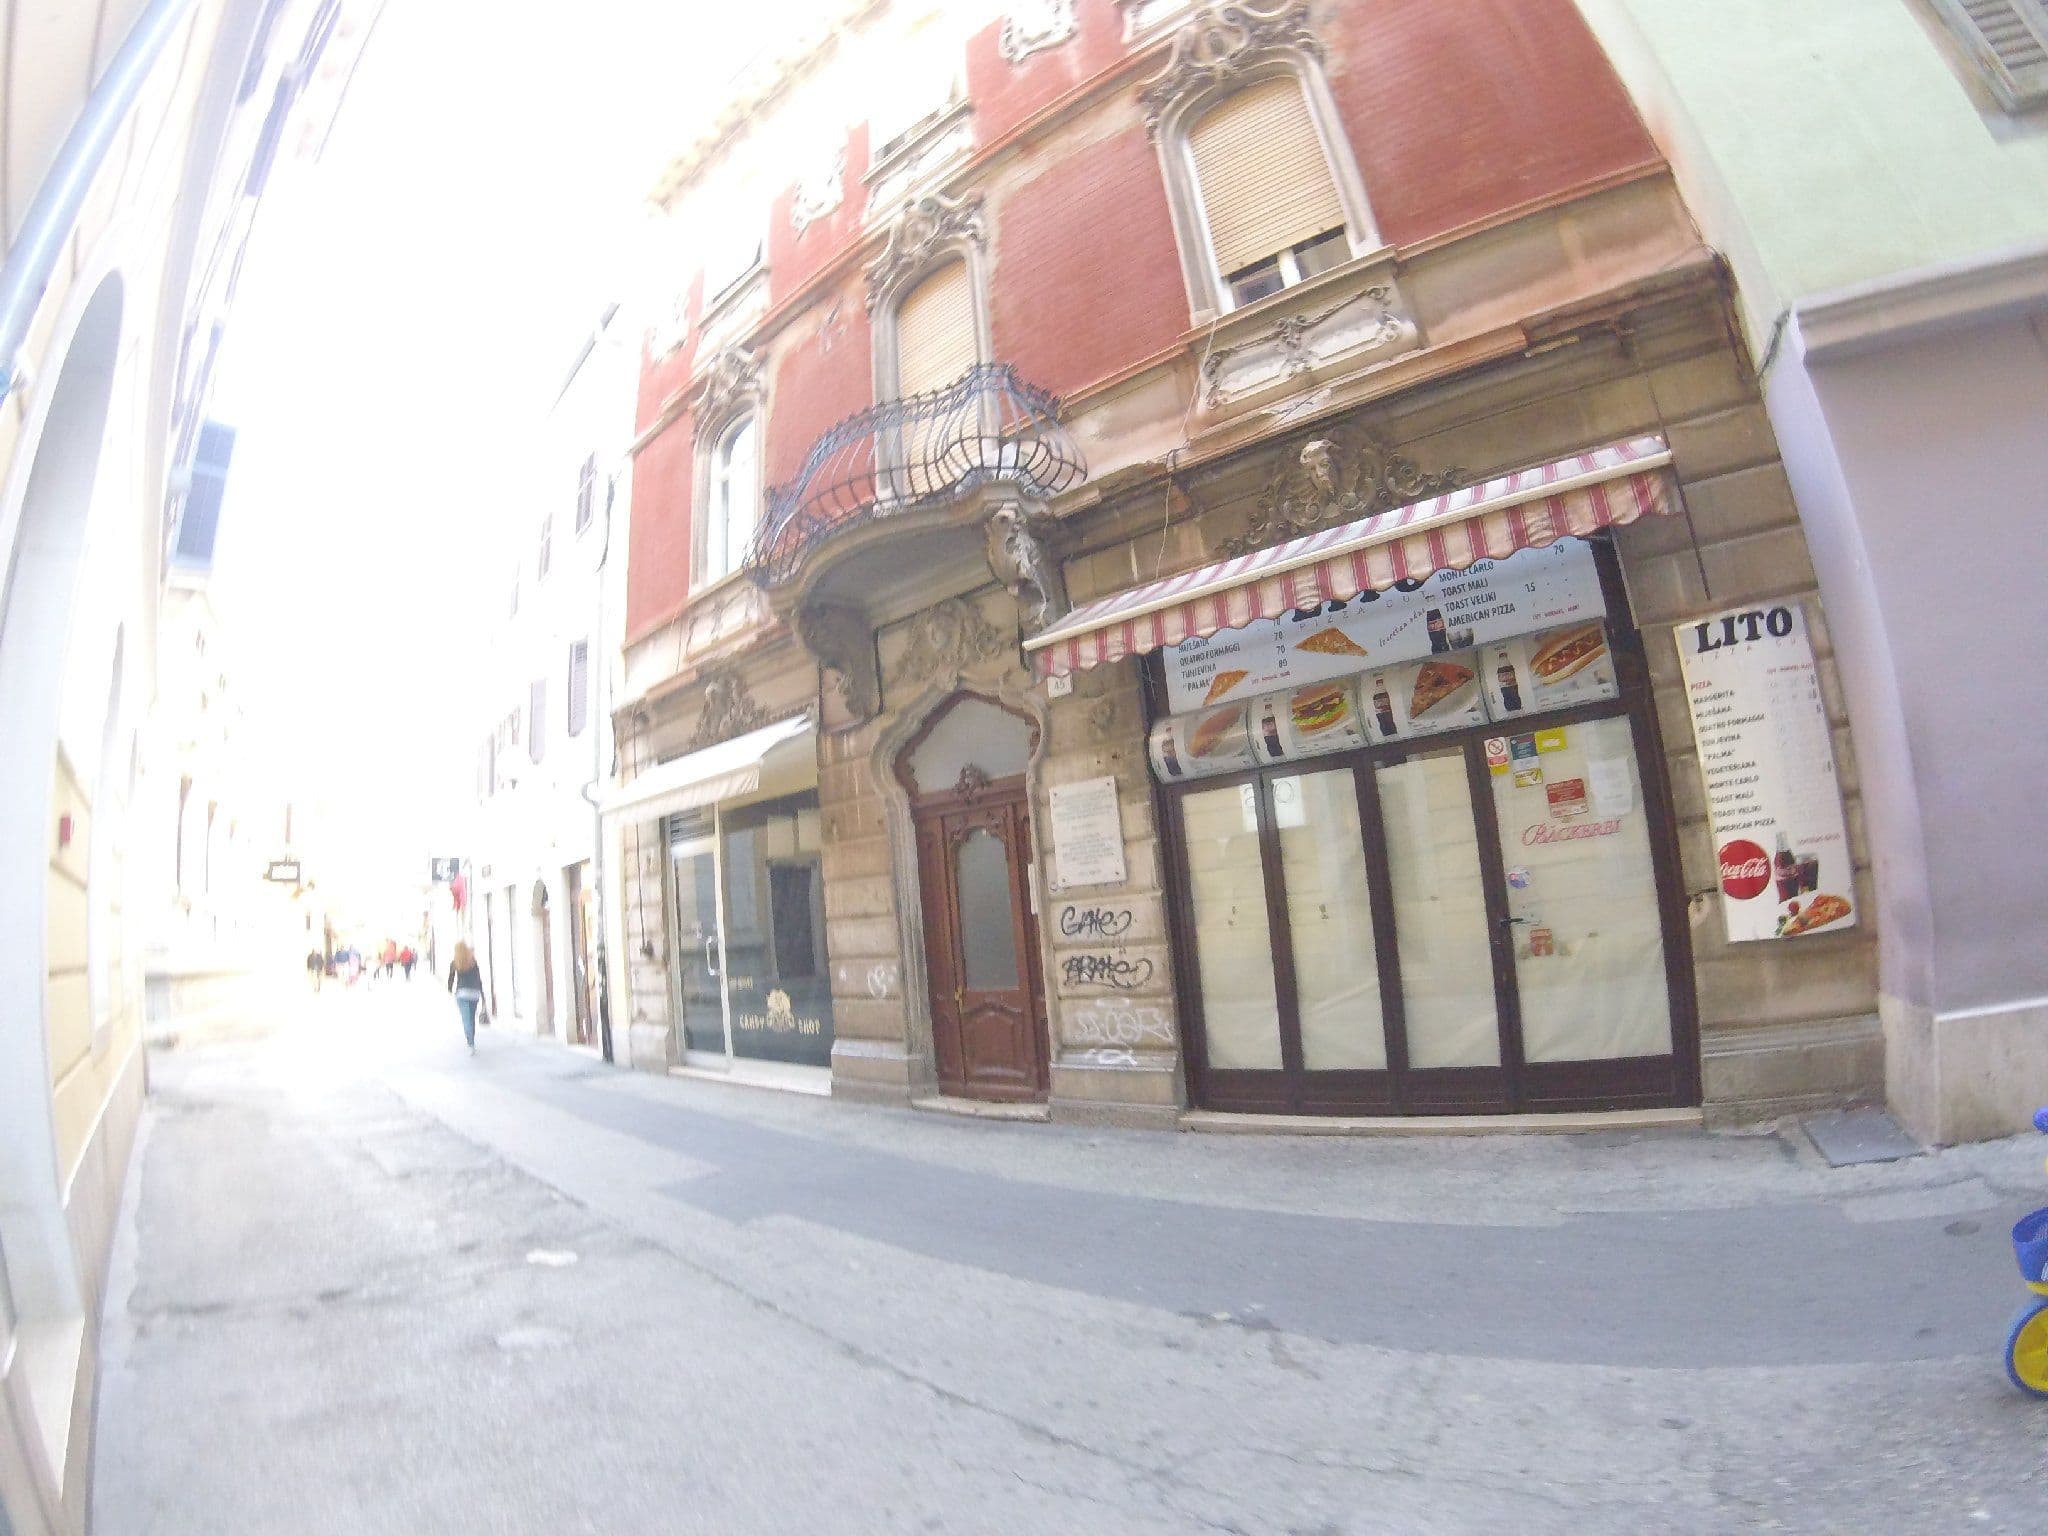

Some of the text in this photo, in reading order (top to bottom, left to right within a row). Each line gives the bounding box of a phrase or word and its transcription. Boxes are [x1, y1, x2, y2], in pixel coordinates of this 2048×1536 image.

[1468, 560, 1494, 575] CARLO
[1441, 580, 1469, 598] TOAST
[1444, 592, 1497, 613] TOAST VELIKI
[1448, 607, 1490, 628] AMERICAN
[1491, 602, 1516, 618] PIZZA
[1694, 607, 1793, 654] LITO
